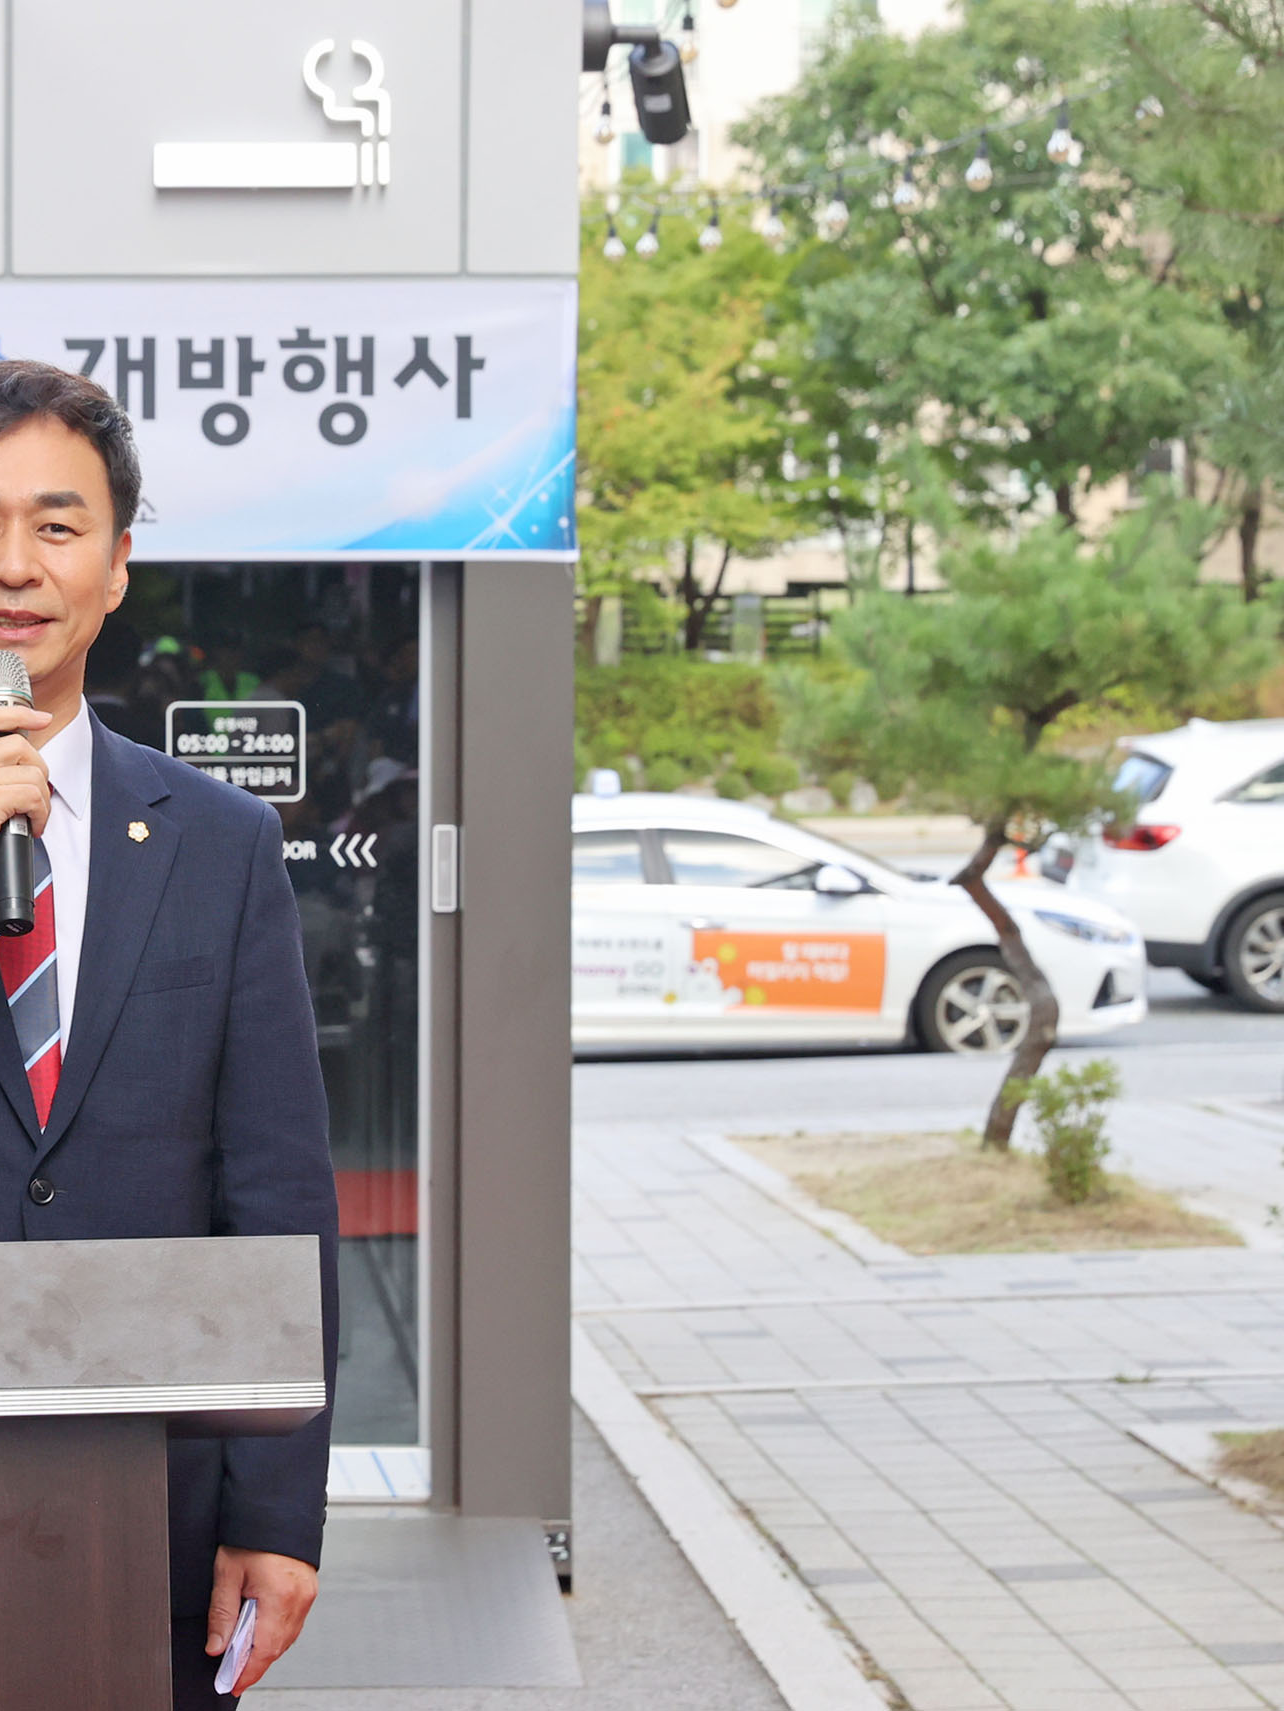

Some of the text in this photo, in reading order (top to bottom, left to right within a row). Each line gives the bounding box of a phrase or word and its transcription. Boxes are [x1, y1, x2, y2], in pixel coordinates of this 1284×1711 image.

[64, 327, 486, 447] 개방행사
[177, 733, 230, 754] 05:00
[242, 733, 295, 754] 24:00
[282, 840, 317, 861] OOR
